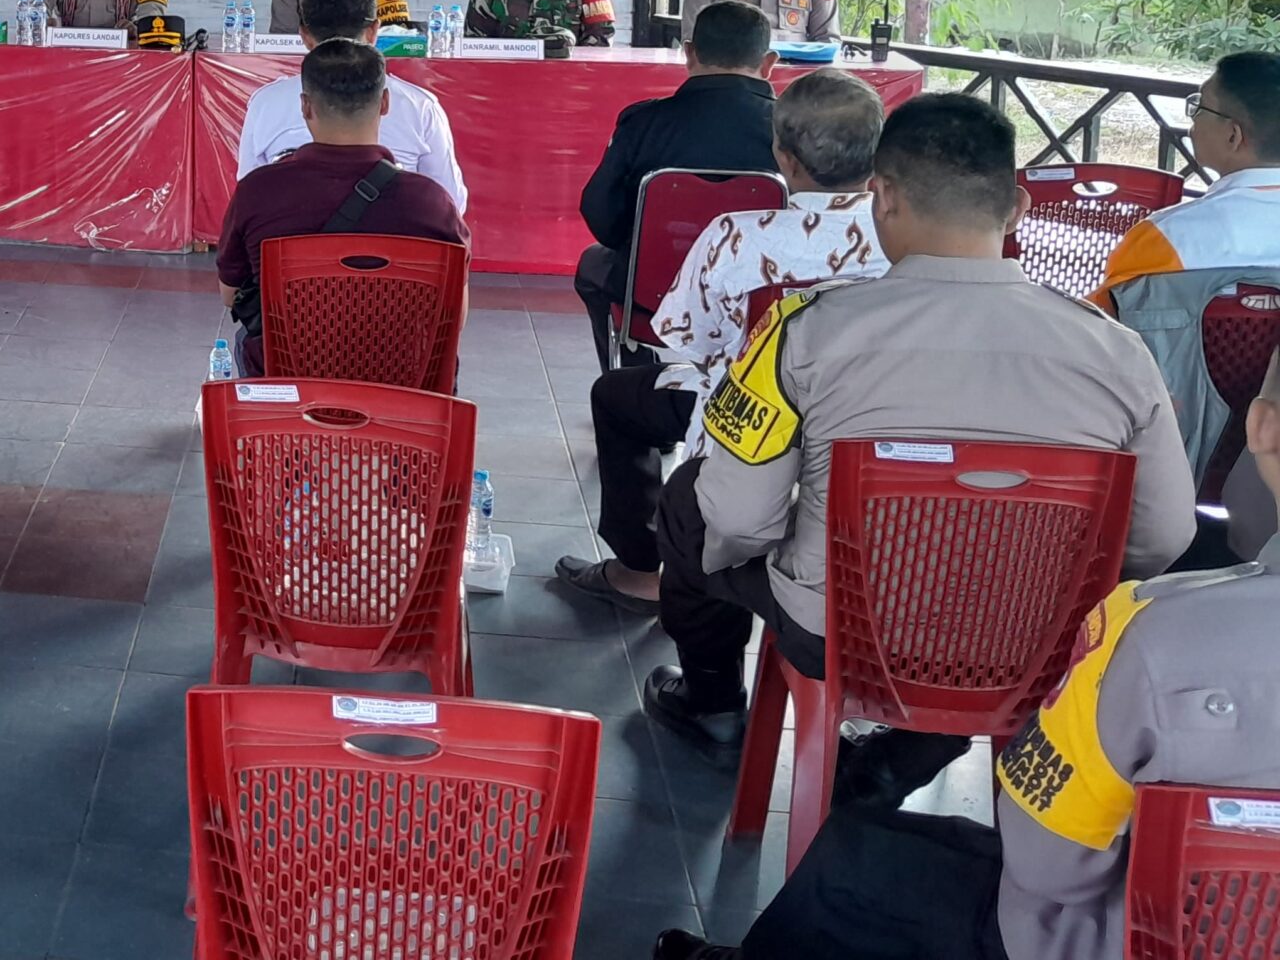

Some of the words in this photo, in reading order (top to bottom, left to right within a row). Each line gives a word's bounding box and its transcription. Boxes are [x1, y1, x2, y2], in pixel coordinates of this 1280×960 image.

[92, 33, 121, 41] LANDAK
[255, 38, 294, 46] KAPOLSEK
[462, 43, 502, 51] DANRAMIL
[503, 44, 537, 52] MANDOR
